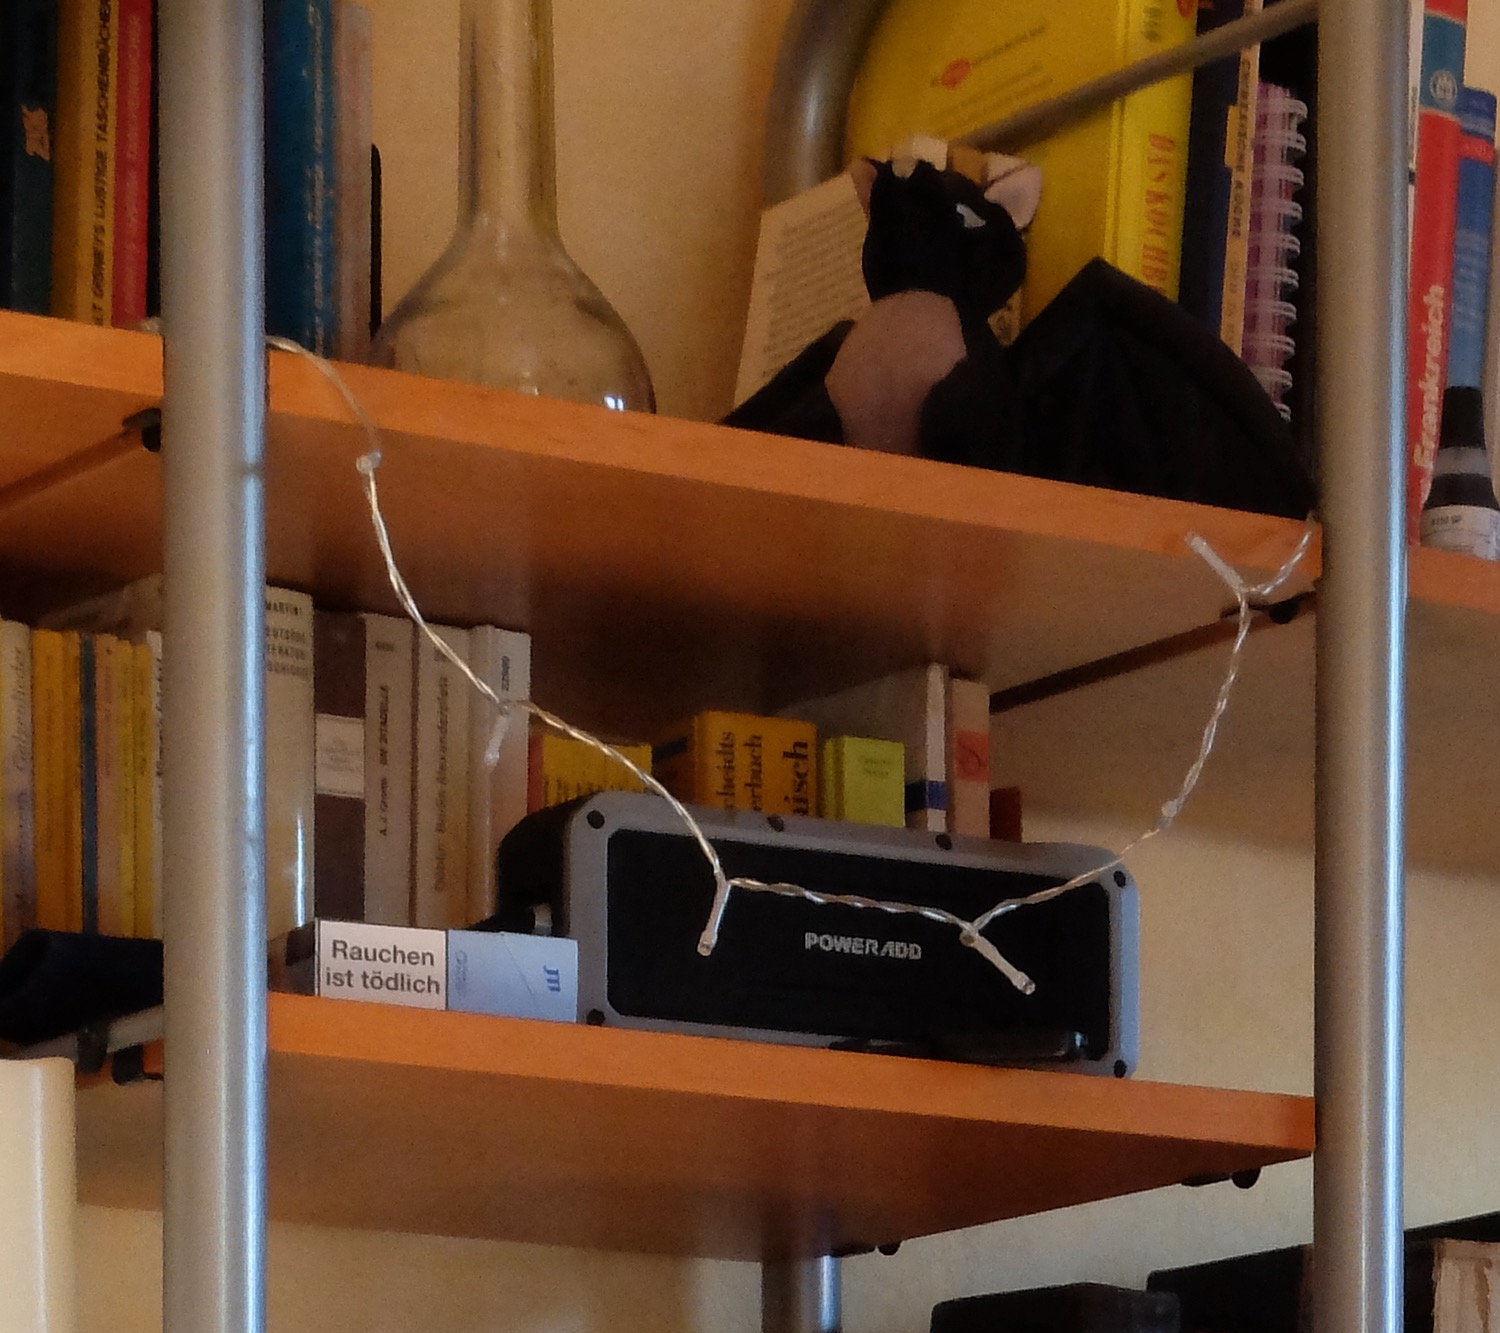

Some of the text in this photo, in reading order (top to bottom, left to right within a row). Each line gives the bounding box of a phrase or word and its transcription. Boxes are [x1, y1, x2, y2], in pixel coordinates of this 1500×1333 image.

[1412, 284, 1445, 468] Frankreich
[331, 939, 435, 967] Rauchen
[326, 967, 355, 988] ist
[361, 969, 441, 996] tödlich
